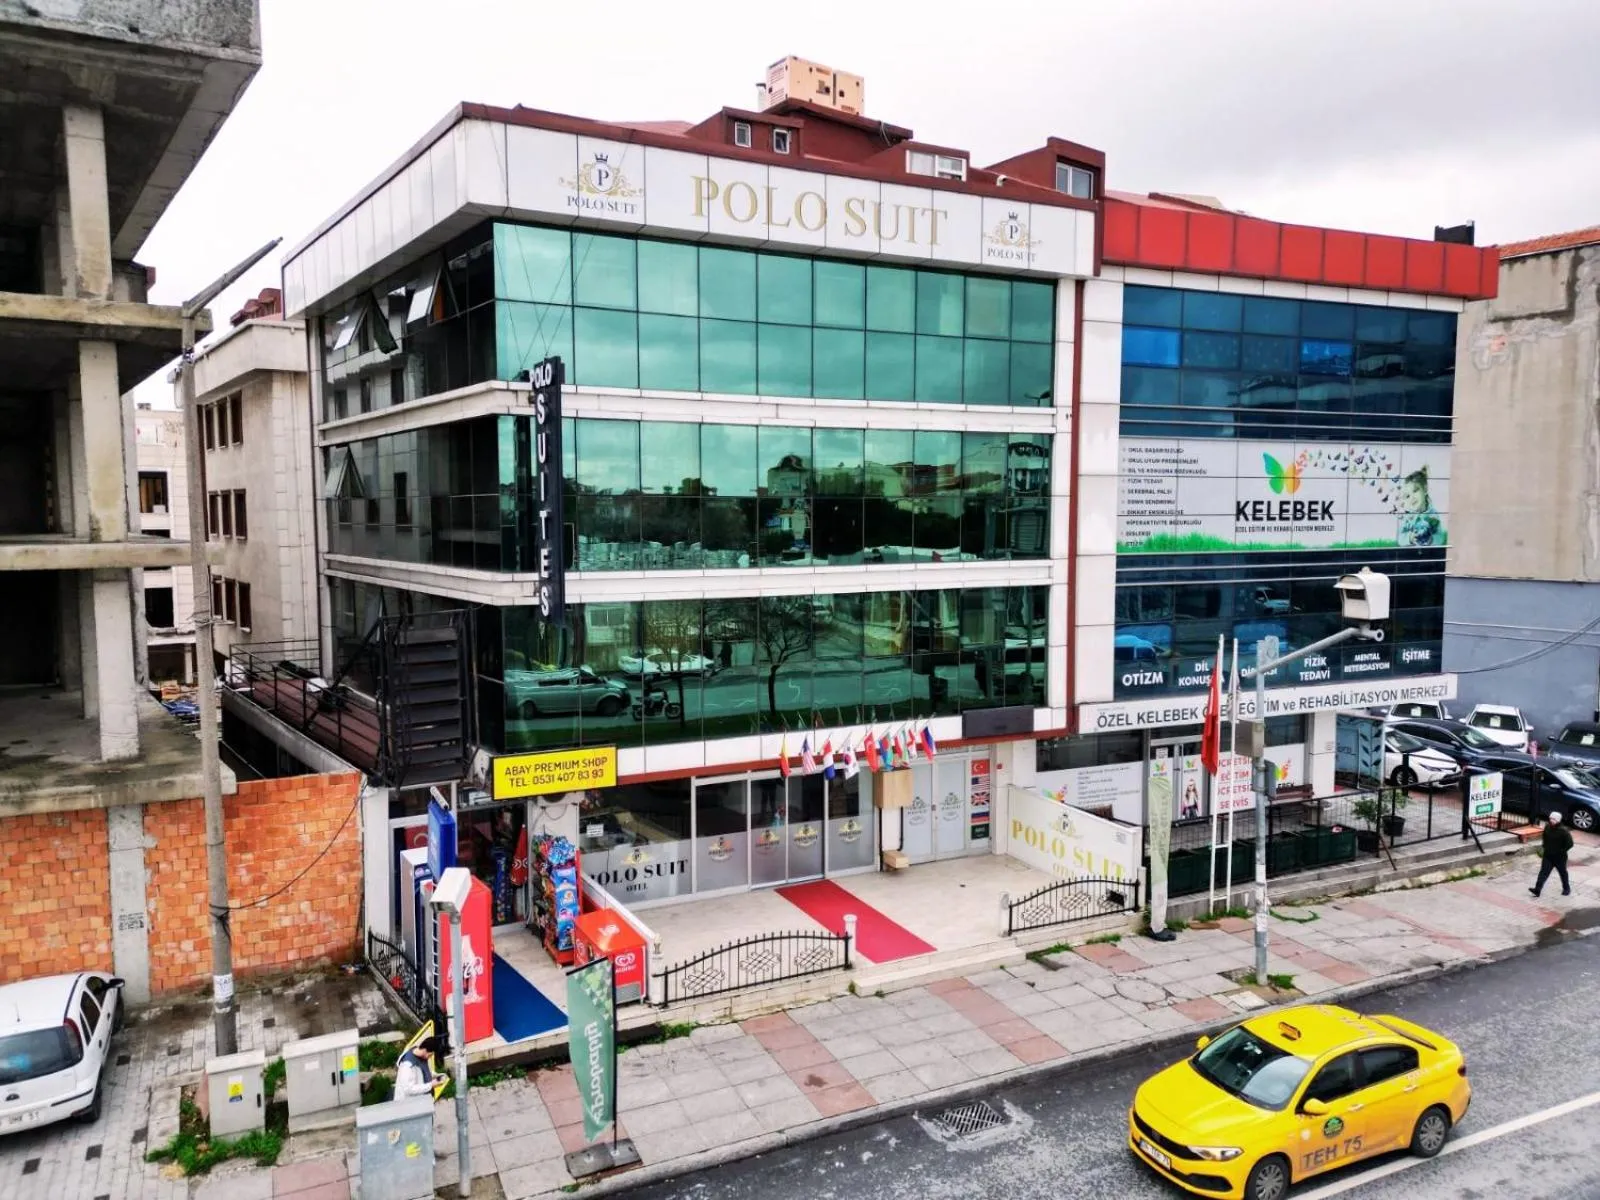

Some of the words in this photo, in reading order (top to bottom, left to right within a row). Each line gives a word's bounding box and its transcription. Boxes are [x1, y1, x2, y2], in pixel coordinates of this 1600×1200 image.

[598, 169, 609, 186] P
[567, 195, 604, 210] POLO
[607, 200, 638, 214] SUIT
[690, 175, 828, 232] POLO
[843, 198, 948, 245] SUIT
[988, 248, 1014, 259] POLO
[1015, 251, 1036, 262] SUIT
[529, 362, 551, 388] POLO
[536, 392, 550, 617] SUITES
[1235, 500, 1335, 521] KELEBEK
[1304, 654, 1328, 668] FİZİK
[1354, 652, 1380, 662] MENTAL
[1402, 647, 1431, 664] İŞİTME
[1194, 659, 1210, 672] DİL
[1299, 667, 1331, 681] TEDAVİ
[1122, 669, 1163, 686] OTİZM
[1097, 711, 1132, 728] ÖZEL
[1137, 707, 1199, 724] KELEBEK
[1282, 700, 1296, 711] ve
[1299, 689, 1398, 710] REHABİLİTASYON
[1400, 683, 1448, 700] MERKEZİ
[504, 764, 531, 776] ABAY
[534, 759, 580, 773] PREMIUM
[582, 756, 608, 769] SHOP
[532, 774, 555, 785] 0531
[557, 771, 575, 782] 407
[577, 770, 590, 780] 83
[591, 768, 604, 779] 93
[1471, 790, 1500, 801] KELEBEK
[1011, 818, 1066, 860] POLO
[590, 866, 638, 885] OLO
[643, 858, 689, 879] SUIT
[1343, 1135, 1364, 1155] 75
